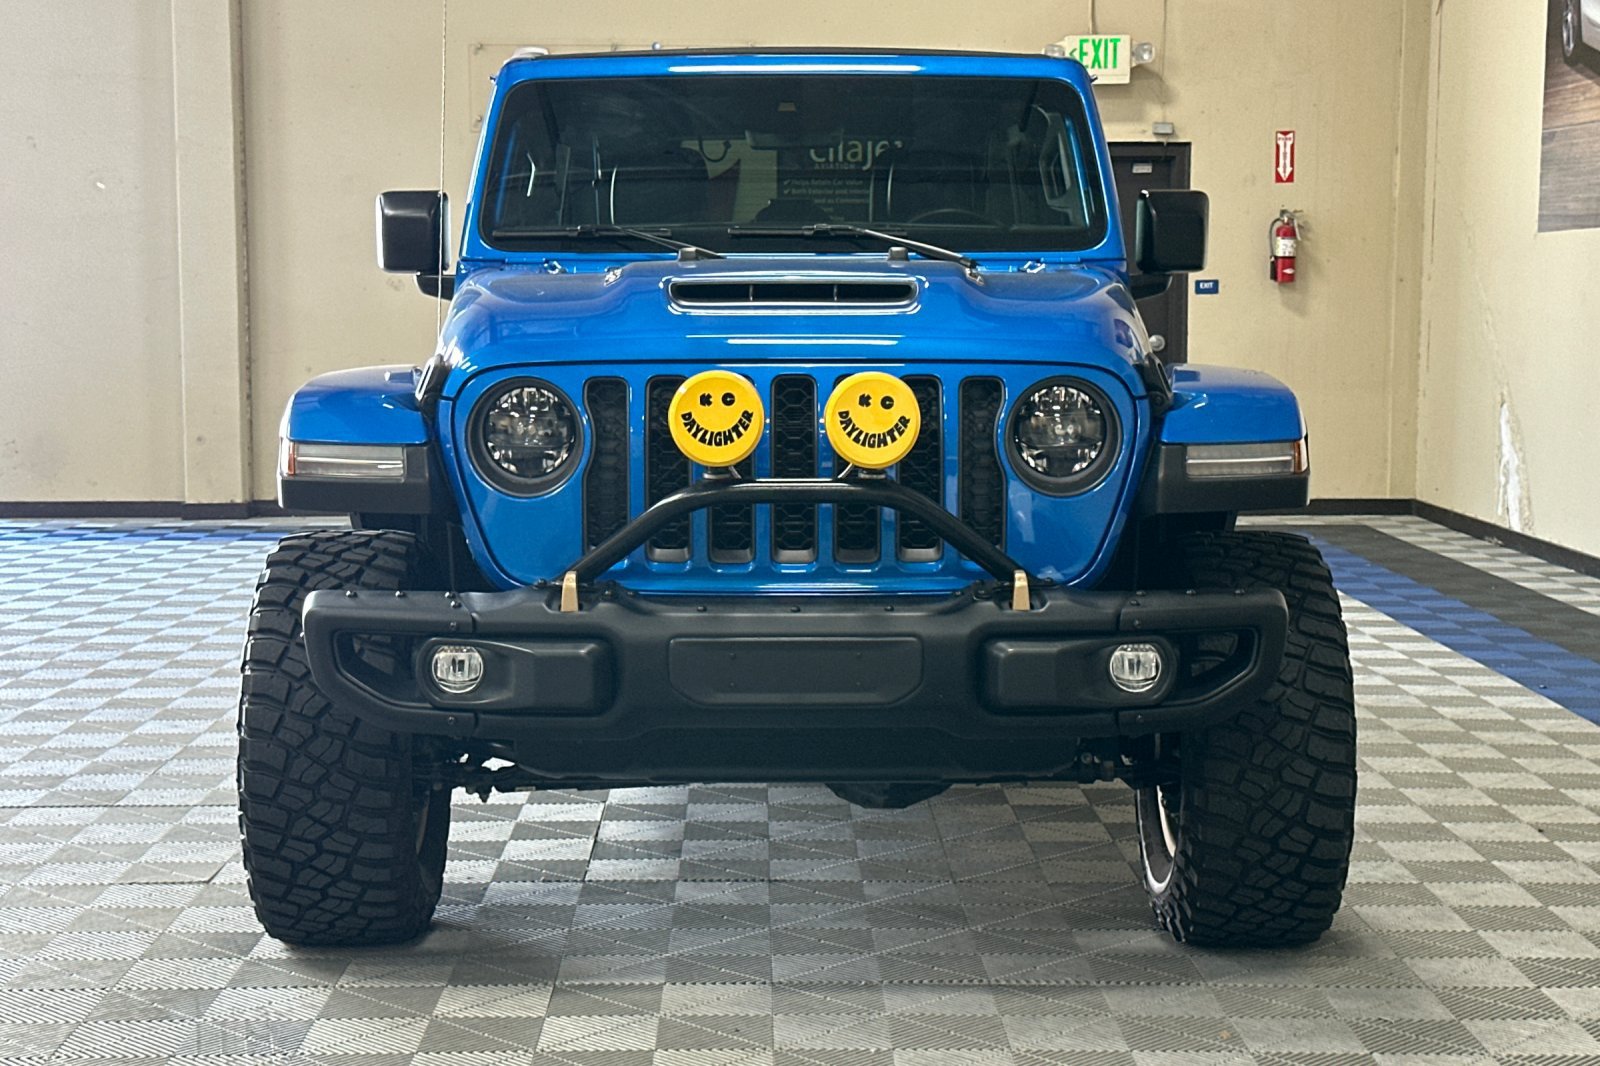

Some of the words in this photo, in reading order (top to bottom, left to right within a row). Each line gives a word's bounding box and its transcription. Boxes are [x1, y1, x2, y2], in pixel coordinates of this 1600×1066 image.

[1079, 38, 1121, 69] EXIT
[1199, 281, 1214, 289] EXIT
[681, 410, 754, 447] DAYLIGHTER
[838, 410, 911, 449] DAYLIGHTER
